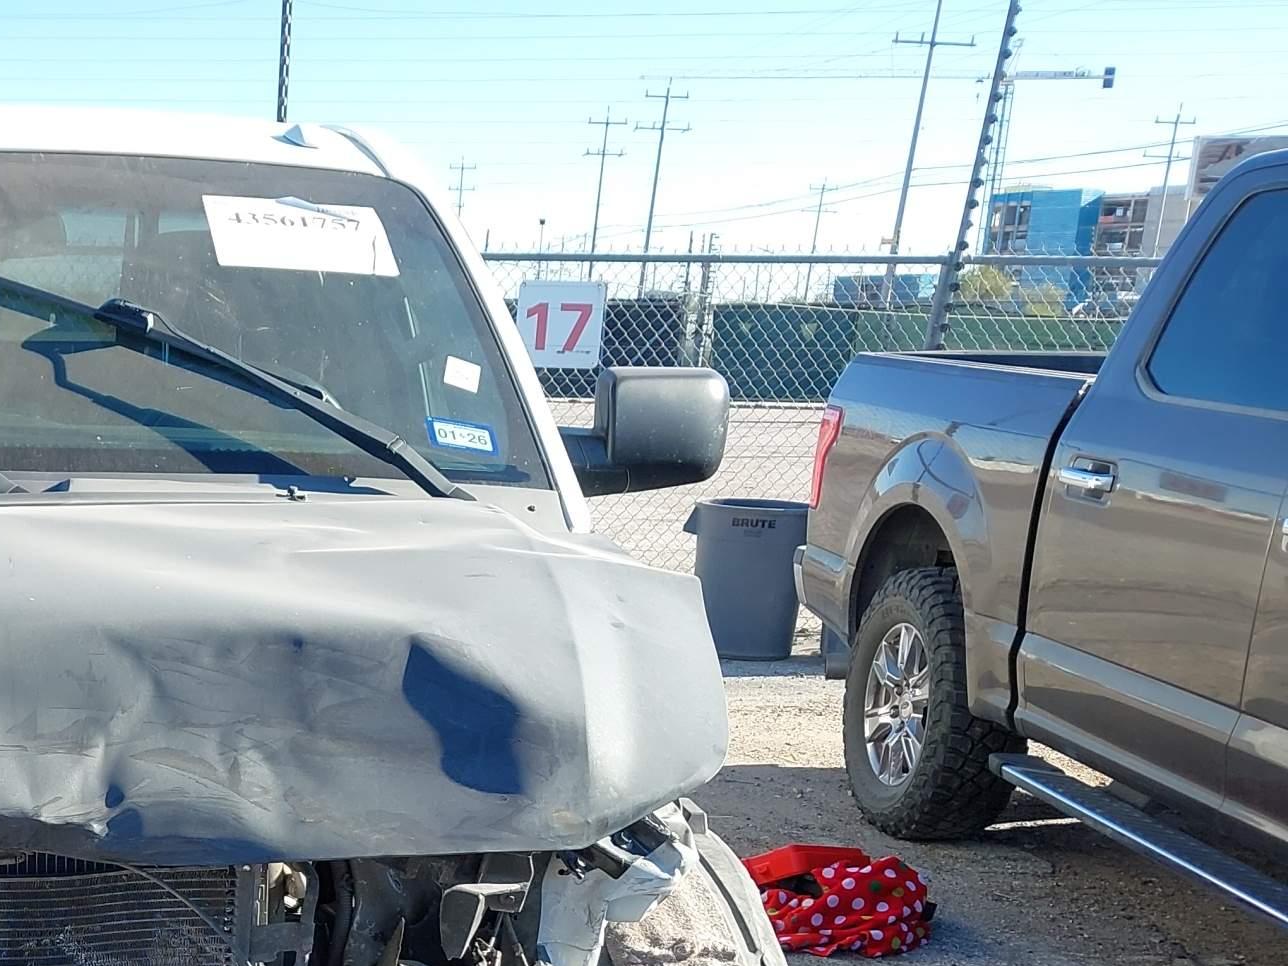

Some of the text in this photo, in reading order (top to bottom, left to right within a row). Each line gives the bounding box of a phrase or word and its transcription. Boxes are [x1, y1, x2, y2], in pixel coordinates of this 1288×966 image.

[228, 211, 361, 232] 43561757
[526, 302, 594, 352] 17
[731, 517, 777, 529] BRUTE
